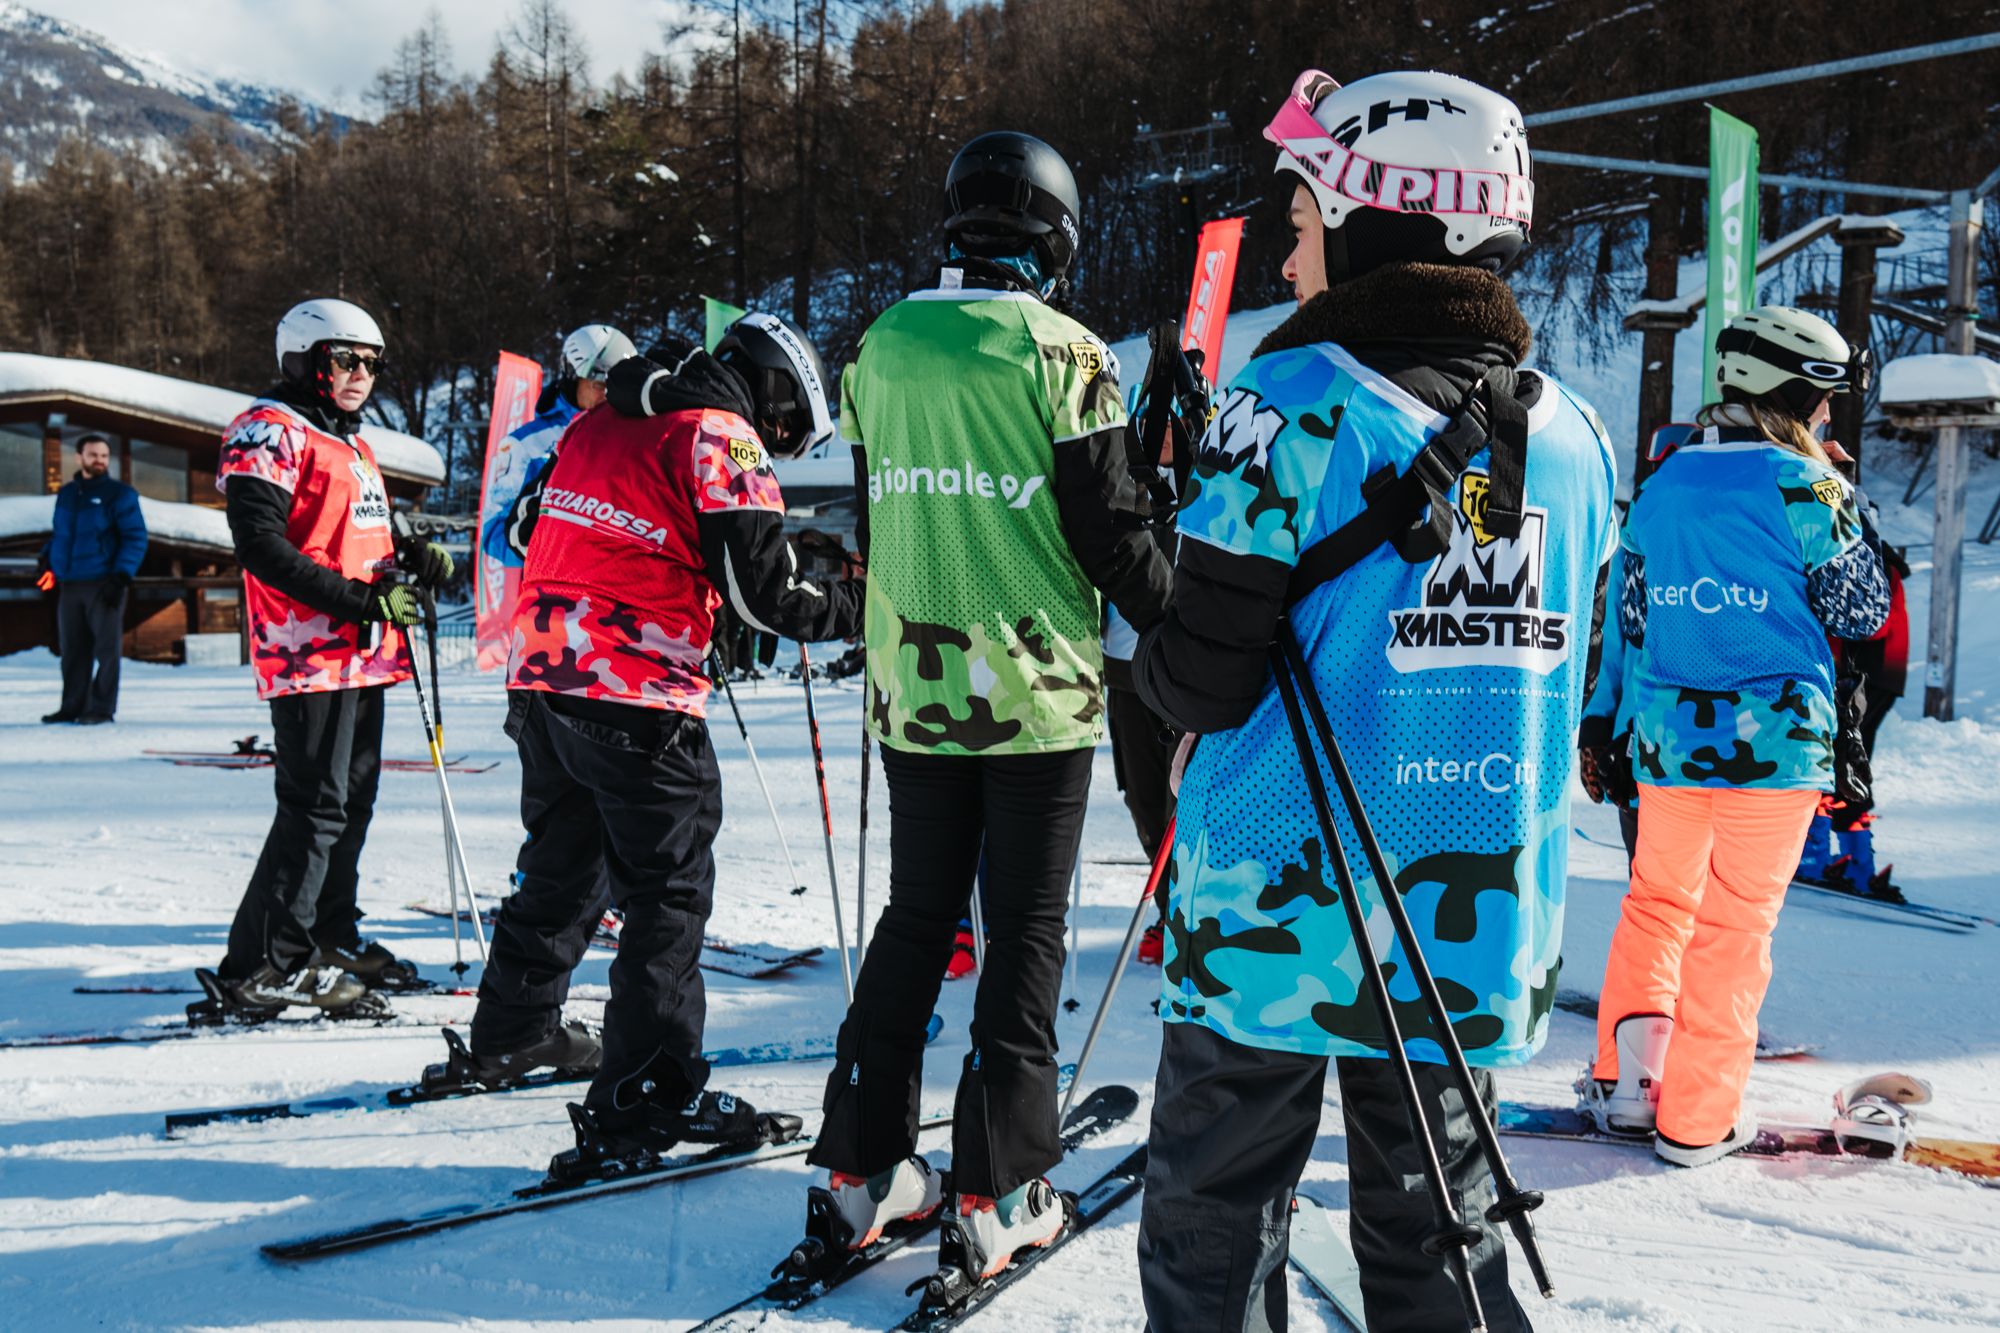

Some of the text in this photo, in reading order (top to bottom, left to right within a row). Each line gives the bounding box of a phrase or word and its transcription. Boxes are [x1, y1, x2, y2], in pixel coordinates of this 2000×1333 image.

[1280, 137, 1533, 221] ALPINA
[782, 333, 820, 393] SPORT
[731, 447, 757, 463] 105
[1818, 486, 1840, 502] 105
[1389, 612, 1566, 651] XMASTERS
[1426, 686, 1473, 695] NATURE
